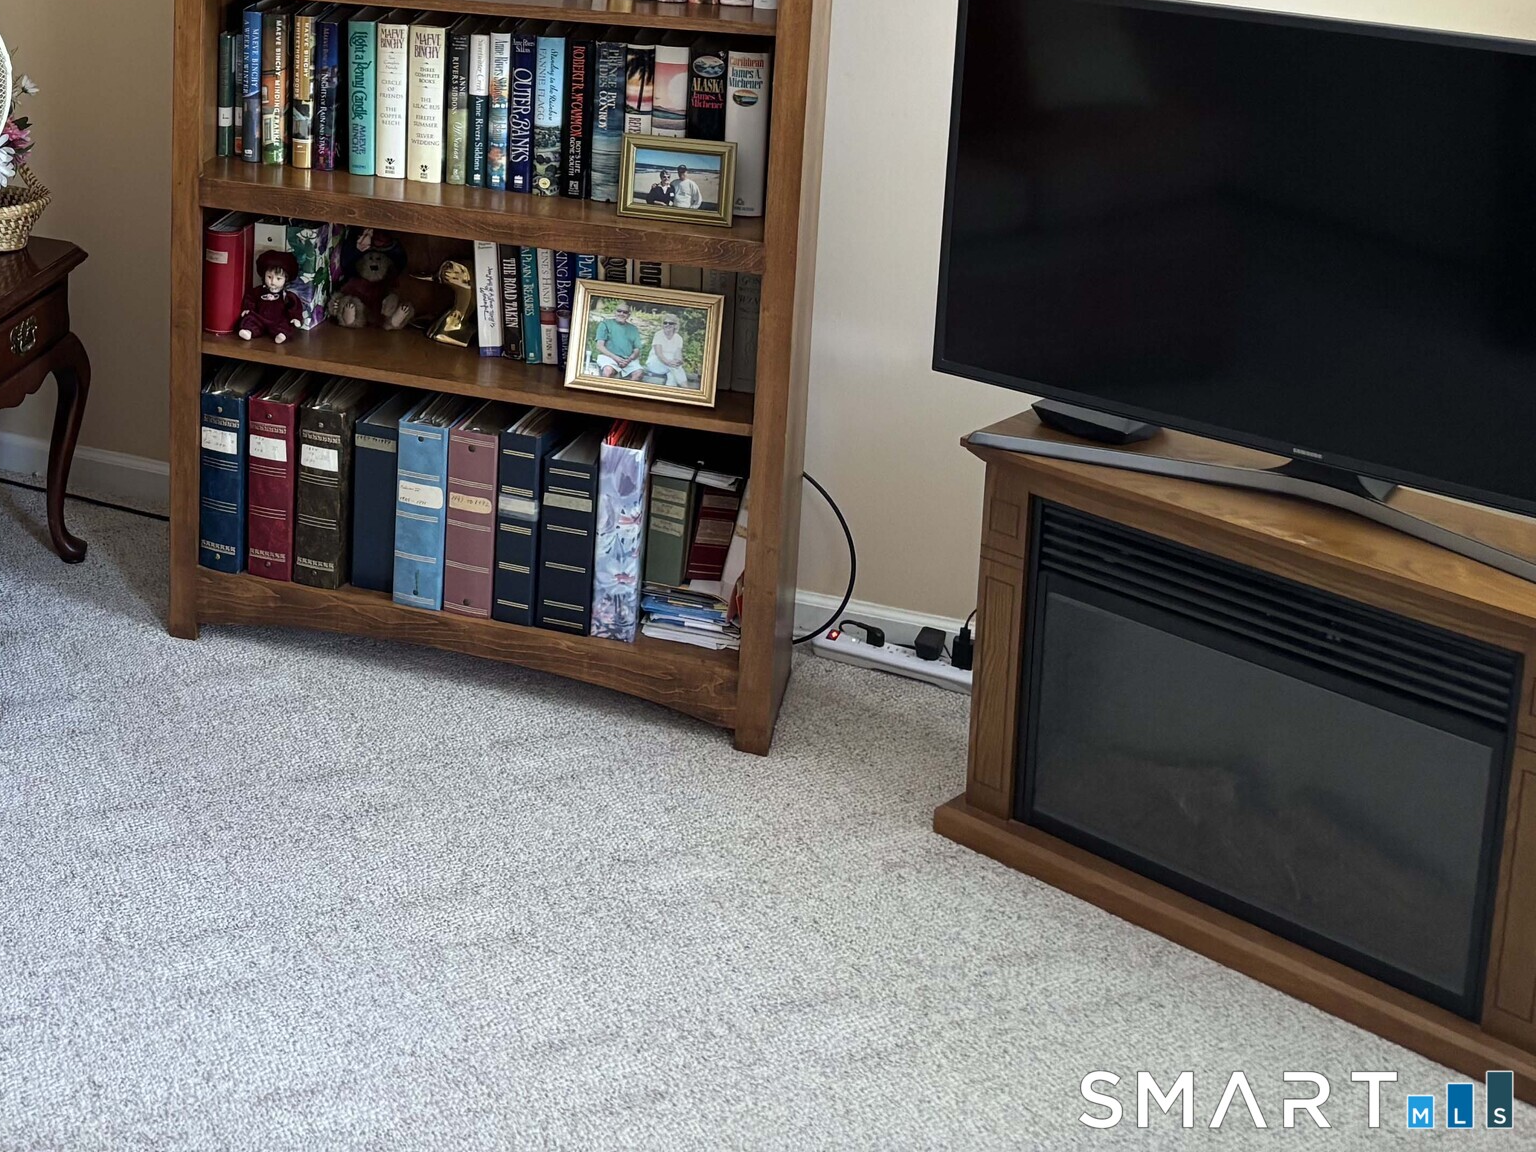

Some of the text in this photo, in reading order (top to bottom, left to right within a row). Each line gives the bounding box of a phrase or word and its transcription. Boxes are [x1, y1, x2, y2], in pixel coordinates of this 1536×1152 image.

[350, 31, 369, 54] Light
[380, 28, 405, 40] MAEVE
[380, 38, 405, 49] BINCHY
[415, 32, 442, 46] MAEVE
[251, 28, 259, 87] MAEVE BINCHY
[274, 48, 282, 76] BINCHY
[414, 45, 441, 59] BINCHY
[493, 39, 508, 76] Anne Rivers
[573, 46, 585, 81] ROBERT
[352, 60, 372, 89] Penny
[451, 56, 459, 115] RIVERS SIDDONS
[537, 48, 546, 121] FANNIE FLAGG
[607, 49, 620, 109] PRINCE PAT
[692, 77, 723, 93] ALASKA
[728, 77, 763, 90] Michener
[731, 68, 754, 79] James
[351, 91, 368, 120] Candle
[598, 58, 609, 130] TIDES CONROY
[691, 98, 724, 109] Michener
[693, 92, 715, 100] James
[317, 106, 327, 123] RAIN
[510, 67, 533, 163] OUTER BANKS
[318, 135, 326, 154] STARS
[351, 123, 360, 156] BINCHY
[358, 124, 367, 155] MAEVE
[474, 96, 484, 171] Anne Rivers Siddons
[503, 258, 519, 328] THE ROAD TAKEN
[521, 253, 535, 316] PLAIN TREASURES
[542, 278, 552, 303] HAND
[557, 280, 572, 308] BACK
